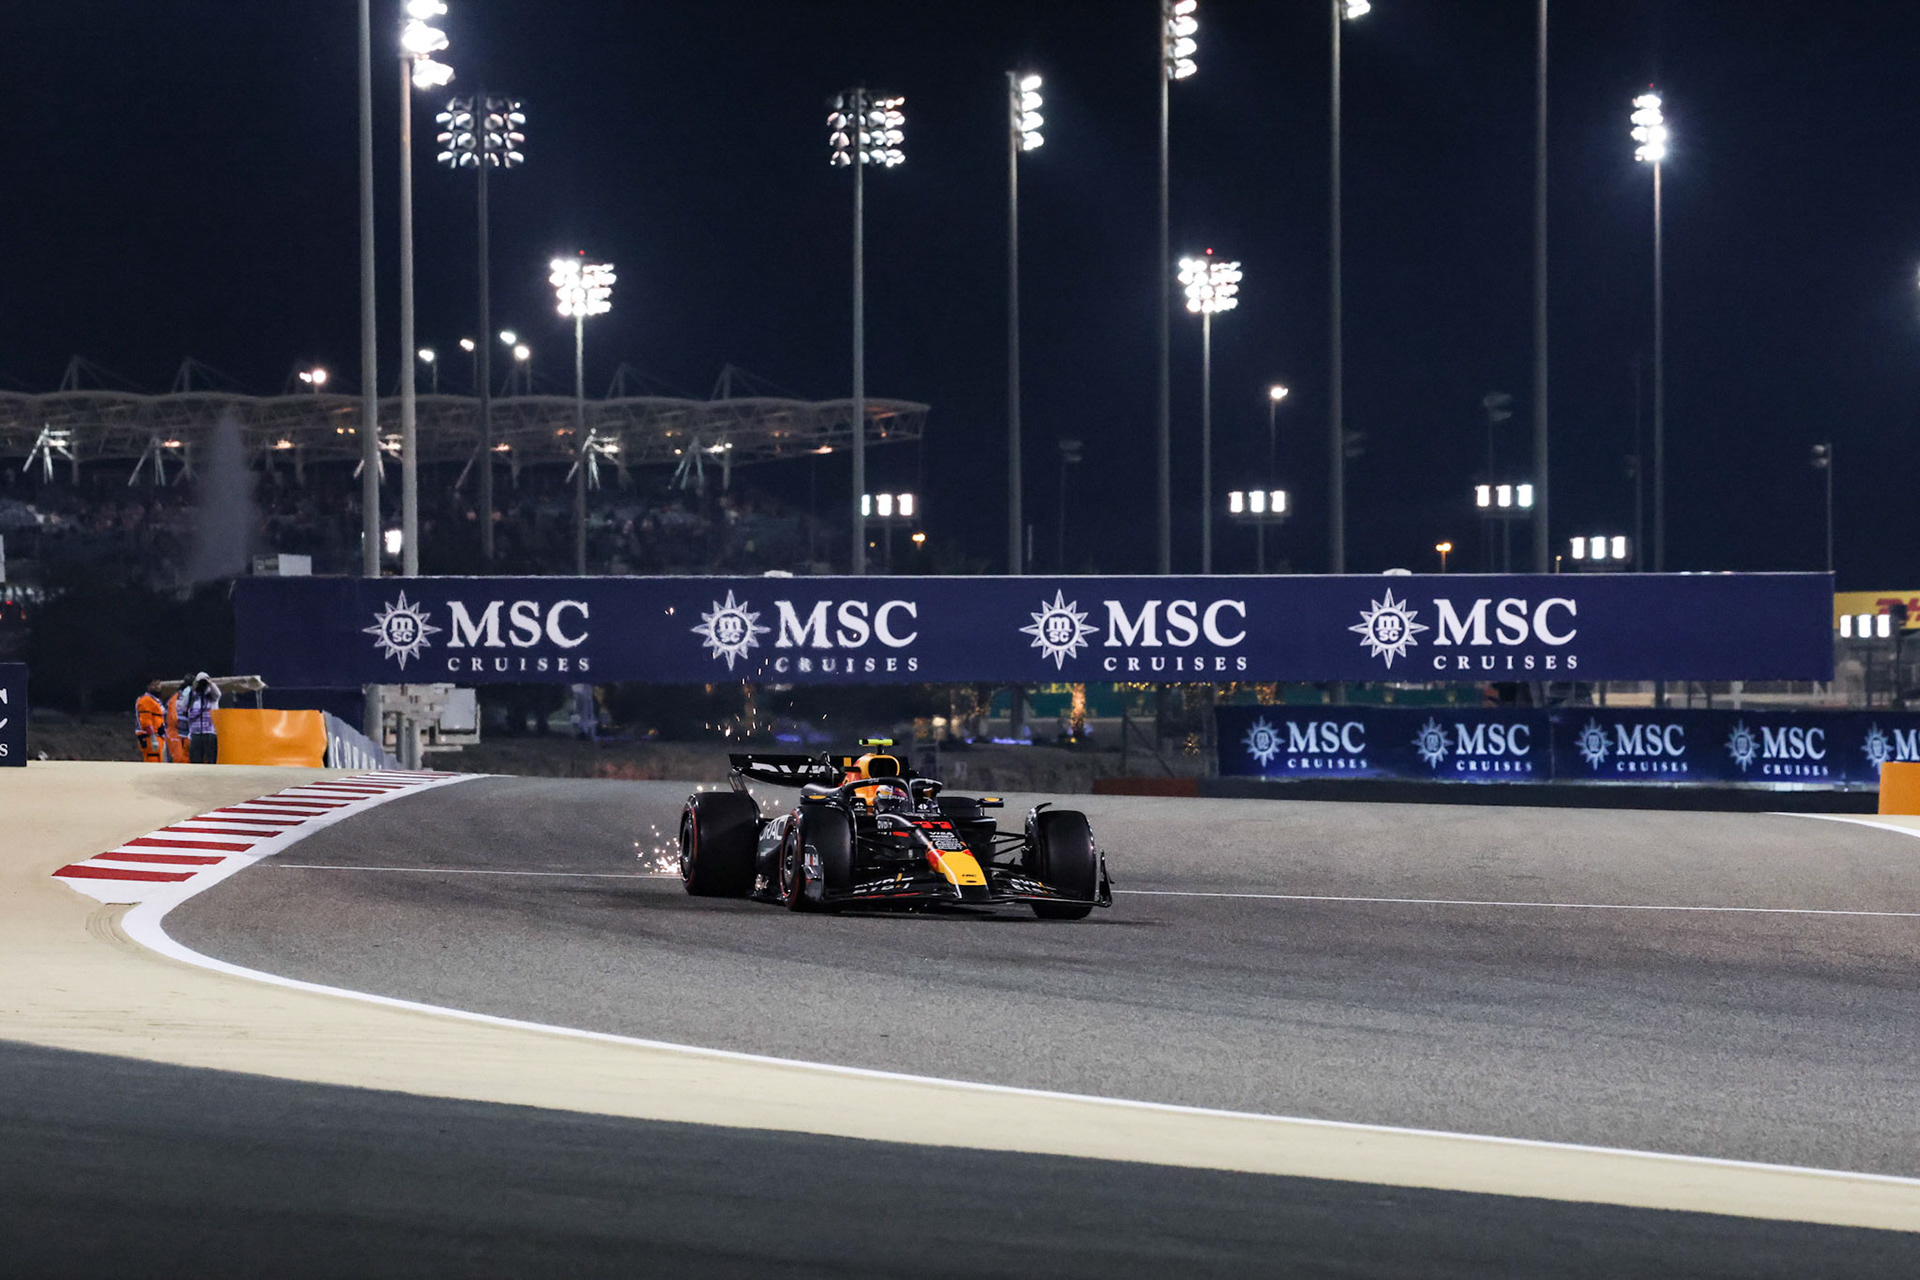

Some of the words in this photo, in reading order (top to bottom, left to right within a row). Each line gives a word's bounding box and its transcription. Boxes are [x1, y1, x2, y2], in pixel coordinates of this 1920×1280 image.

[446, 600, 589, 648] MSC
[774, 600, 918, 648] MSC
[1103, 599, 1247, 647] MSC
[1433, 598, 1577, 646] MSC
[447, 657, 590, 672] CRUISES
[775, 657, 918, 672] CRUISES
[1103, 656, 1247, 671] CRUISES
[1433, 655, 1578, 670] CRUISES
[1287, 721, 1365, 753] MSC
[1455, 723, 1530, 756] MSC
[1615, 724, 1686, 756] MSC
[1761, 726, 1826, 760] MSC
[1287, 758, 1367, 769] CRUISES
[1456, 760, 1532, 772] CRUISES
[1616, 761, 1688, 772] CRUISES
[1763, 764, 1829, 776] CRUISES
